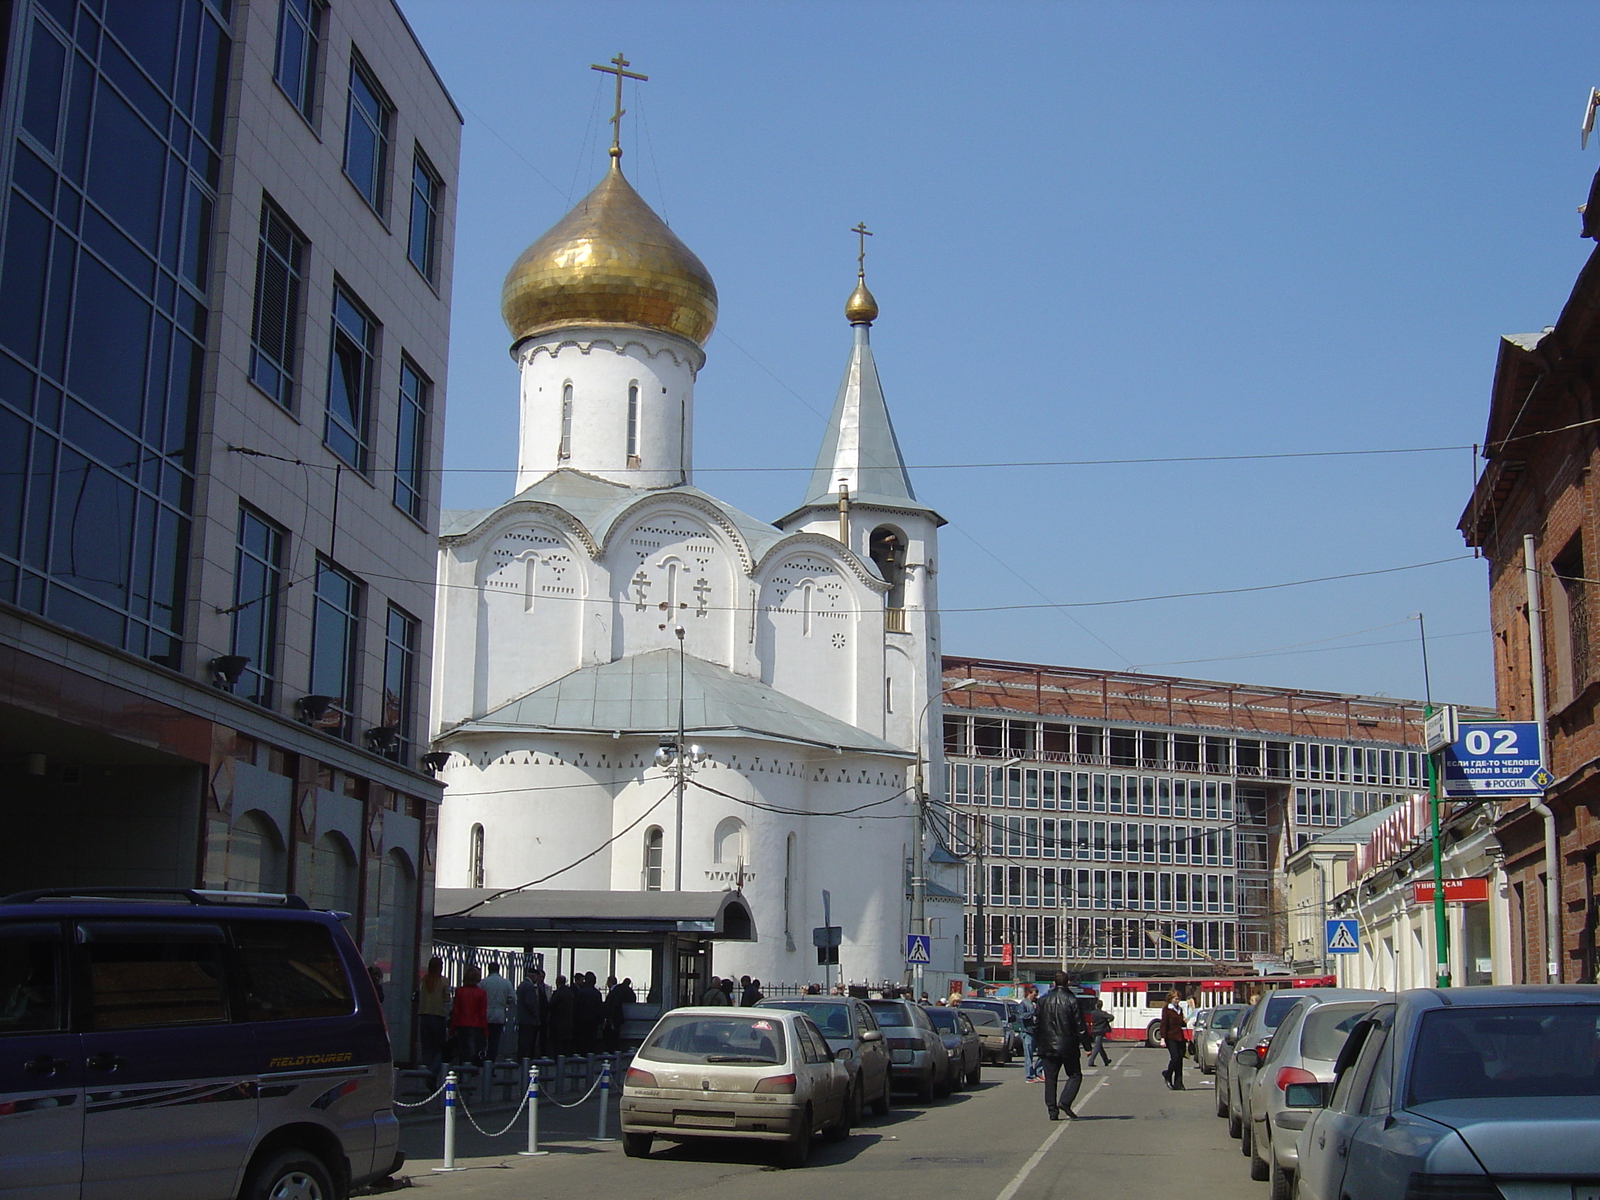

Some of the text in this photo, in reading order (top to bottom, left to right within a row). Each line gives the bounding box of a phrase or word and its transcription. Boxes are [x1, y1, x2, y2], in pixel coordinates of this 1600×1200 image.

[1465, 730, 1519, 755] 02
[1502, 767, 1524, 775] БЕДУ
[1493, 780, 1526, 788] РОССИЯ
[1416, 881, 1463, 890] УНИВРСАМ
